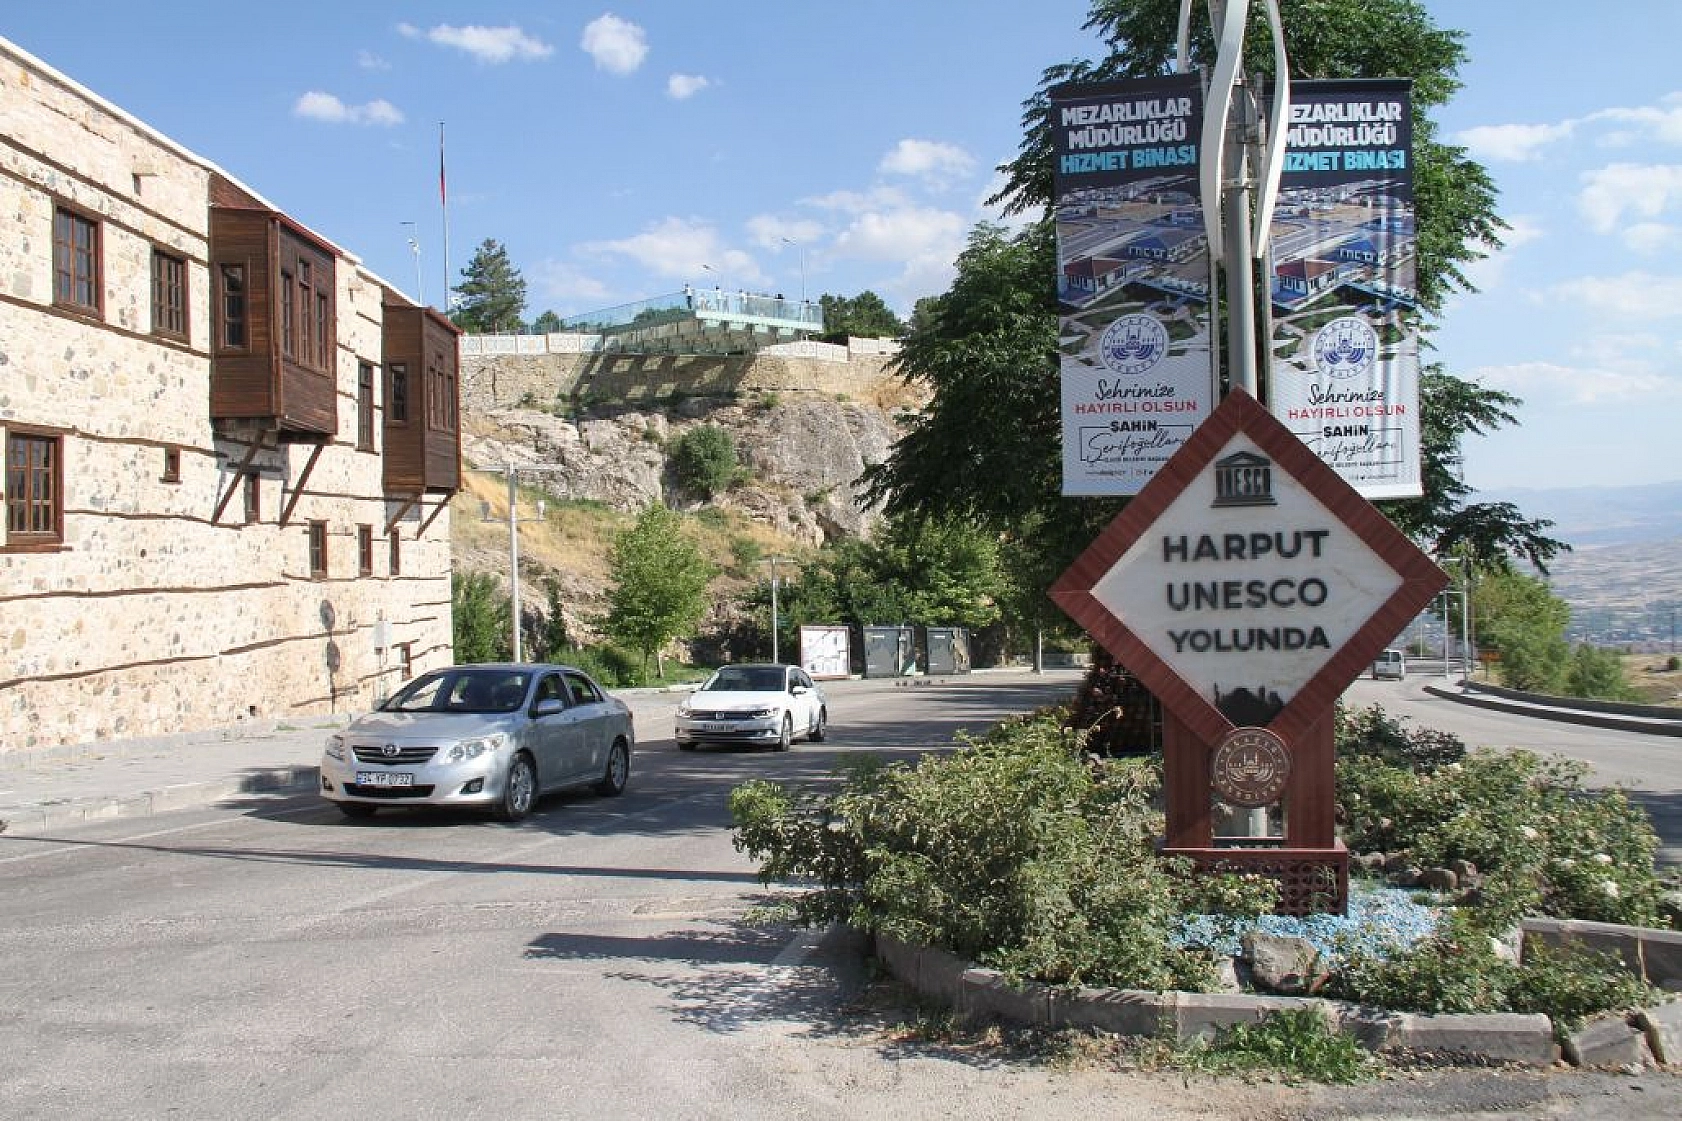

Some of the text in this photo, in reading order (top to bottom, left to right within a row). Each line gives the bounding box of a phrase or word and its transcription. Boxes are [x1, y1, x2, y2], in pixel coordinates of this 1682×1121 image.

[1061, 97, 1191, 126] MEZARLIKLAR
[1288, 102, 1401, 123] EZARLIKLAR
[1069, 118, 1186, 149] MÜDÜRLÜĞÜ
[1132, 145, 1196, 169] BİNASI
[1344, 149, 1406, 170] BİNASI
[1075, 401, 1197, 414] HAYIRLI OLSUN
[1288, 405, 1405, 420] HAYIRLI OLSUN
[1162, 529, 1329, 563] HARPUT
[1166, 577, 1328, 612] UNESCO
[1167, 626, 1331, 653] YOLUNDA
